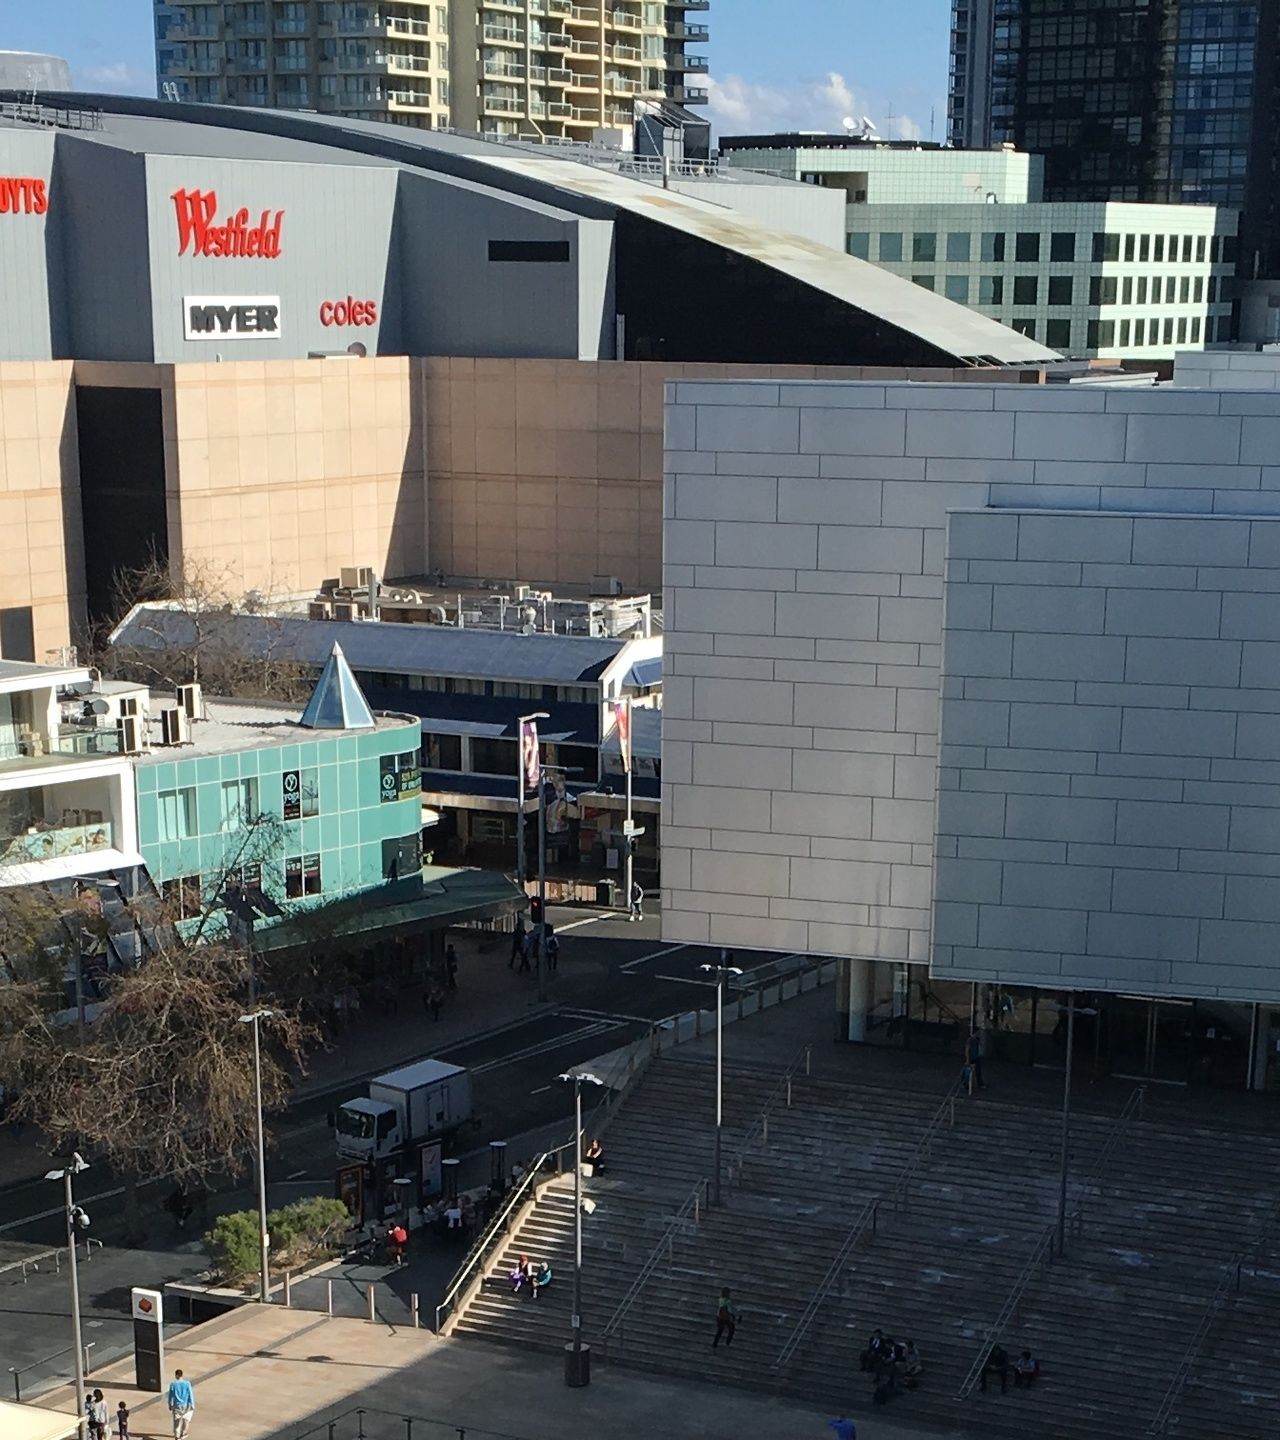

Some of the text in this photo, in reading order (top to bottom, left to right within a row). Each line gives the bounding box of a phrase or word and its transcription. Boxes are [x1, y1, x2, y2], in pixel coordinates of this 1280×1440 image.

[170, 187, 285, 259] Westfield
[189, 305, 279, 333] MYER
[319, 295, 378, 327] coles
